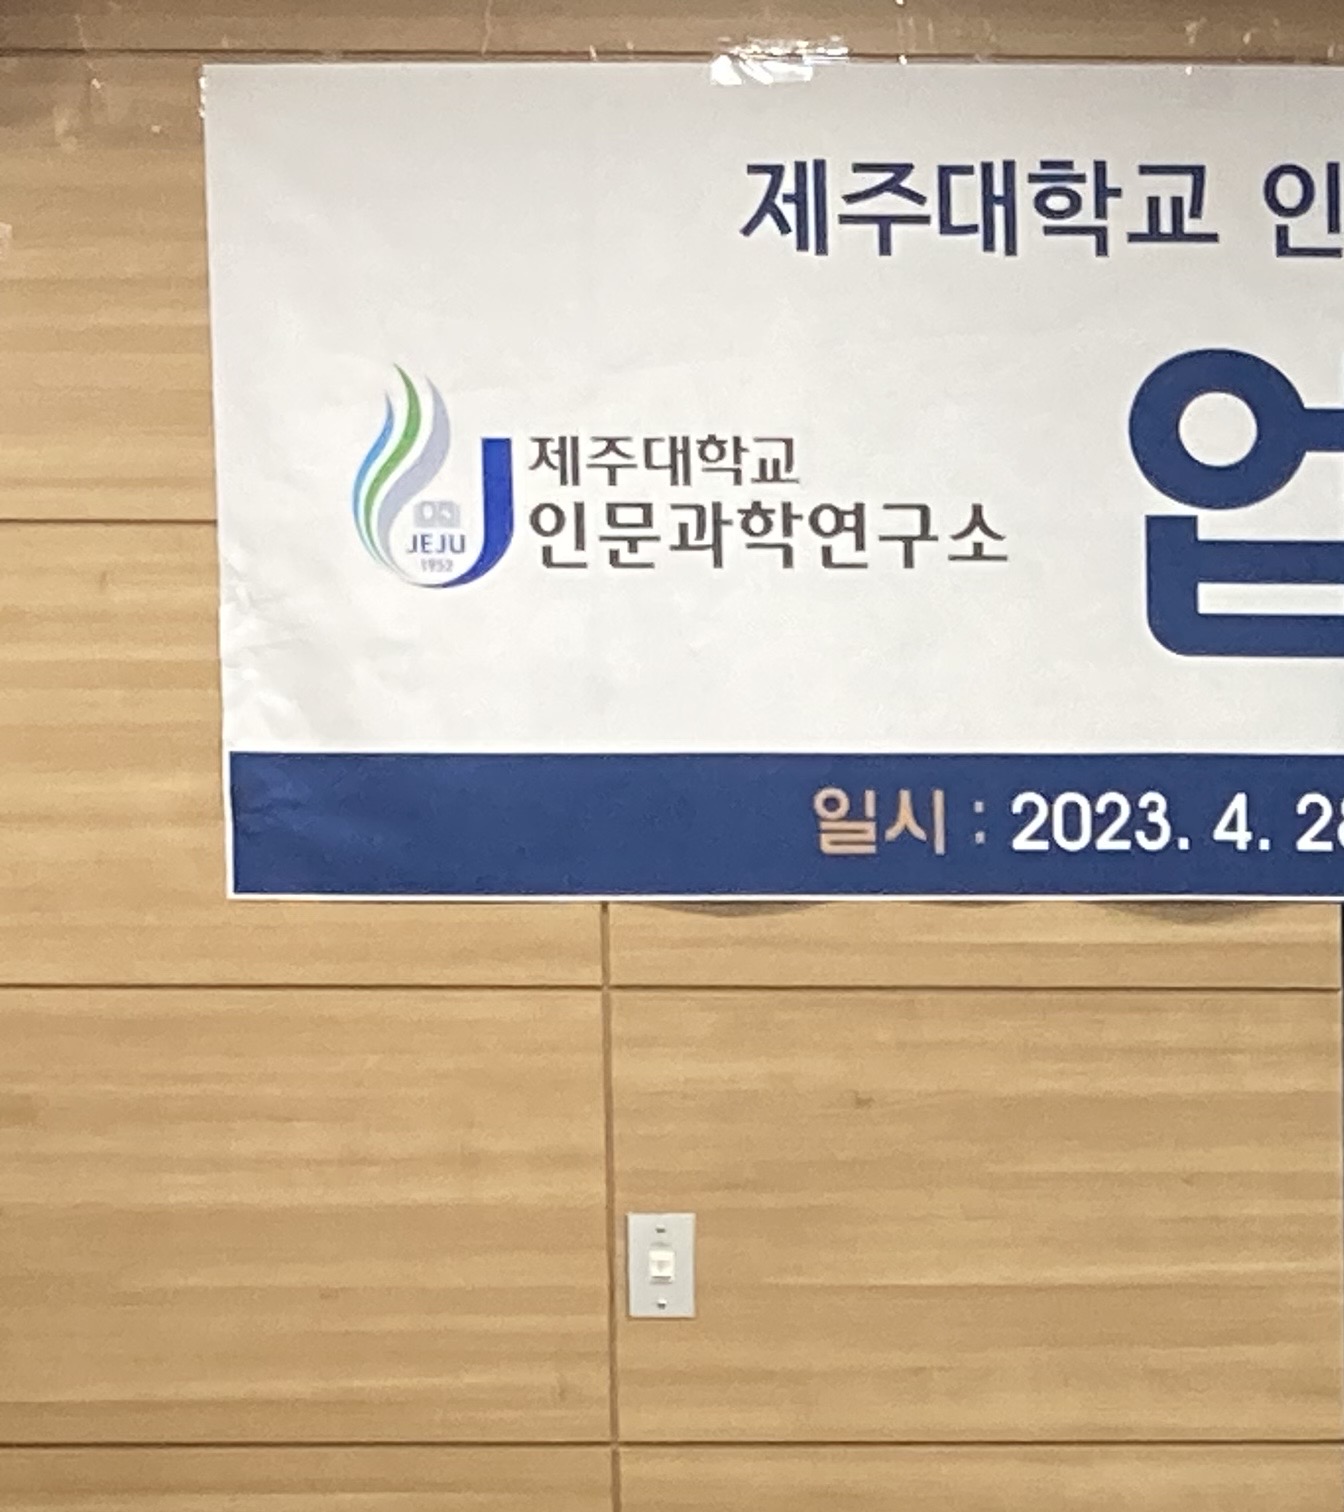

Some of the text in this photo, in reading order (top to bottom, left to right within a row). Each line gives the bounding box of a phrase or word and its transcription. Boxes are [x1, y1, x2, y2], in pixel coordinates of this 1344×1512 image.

[740, 159, 1219, 257] 제주대학교
[529, 434, 799, 486] 제주대학교
[405, 534, 466, 554] JEJU
[529, 501, 1008, 569] 인문과학연구소
[421, 558, 453, 573] 1952
[814, 787, 945, 854] 일시
[1012, 791, 1189, 852] 2023.
[1213, 793, 1270, 851] 4.
